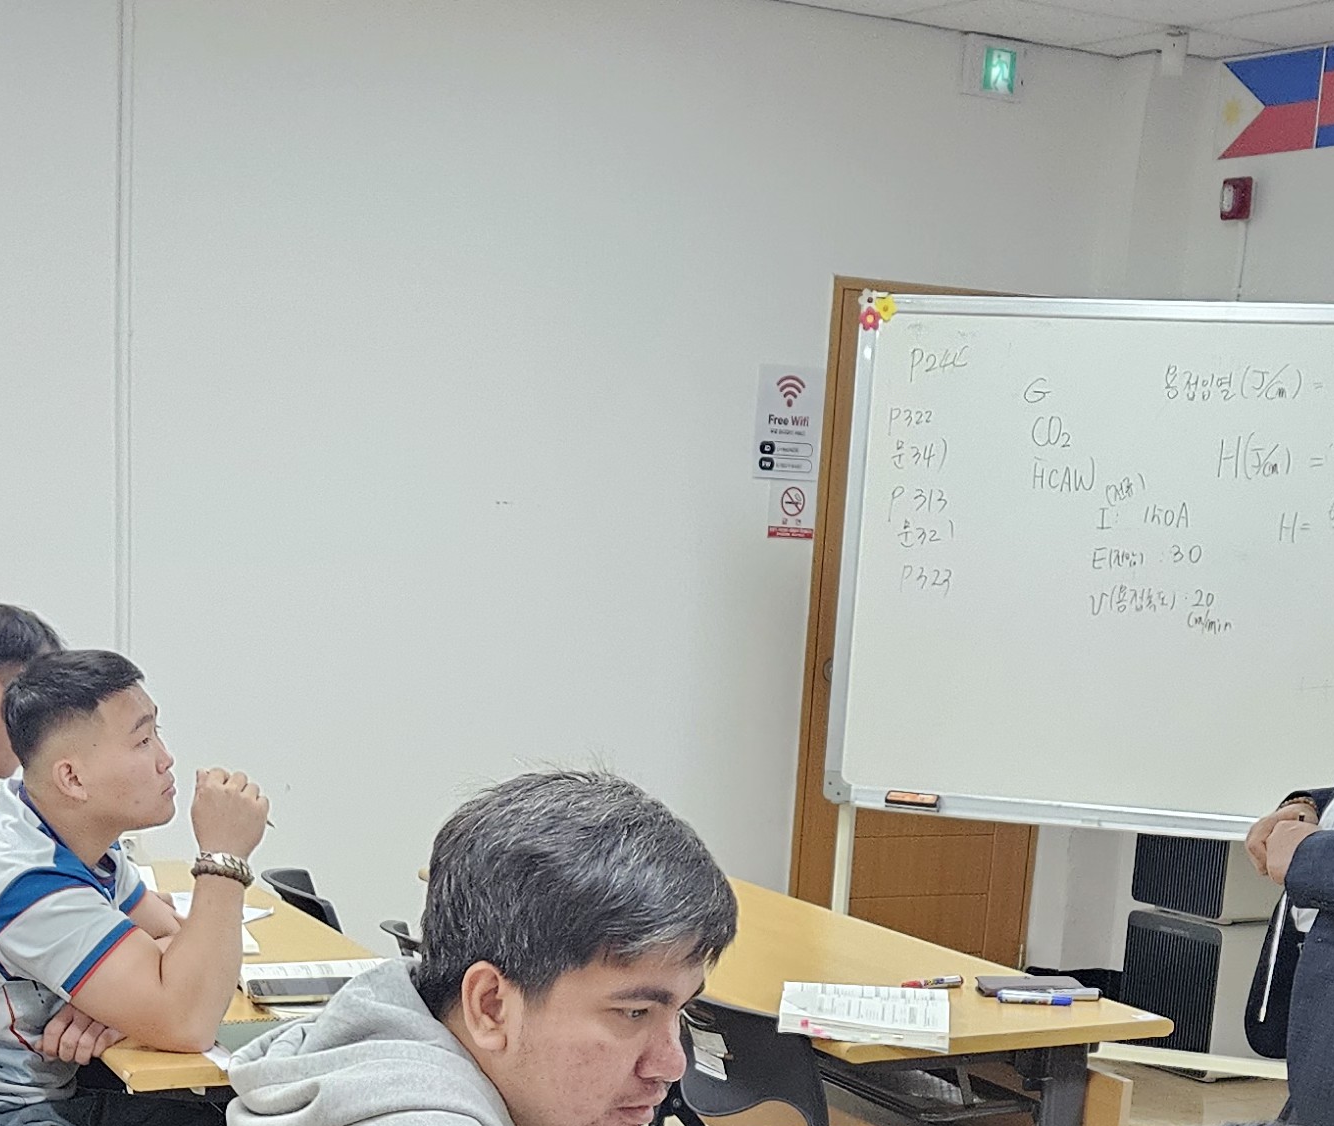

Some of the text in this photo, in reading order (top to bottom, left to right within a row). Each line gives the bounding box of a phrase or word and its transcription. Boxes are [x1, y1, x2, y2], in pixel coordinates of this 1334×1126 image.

[1023, 377, 1052, 404] G
[768, 413, 809, 427] Free Wifi
